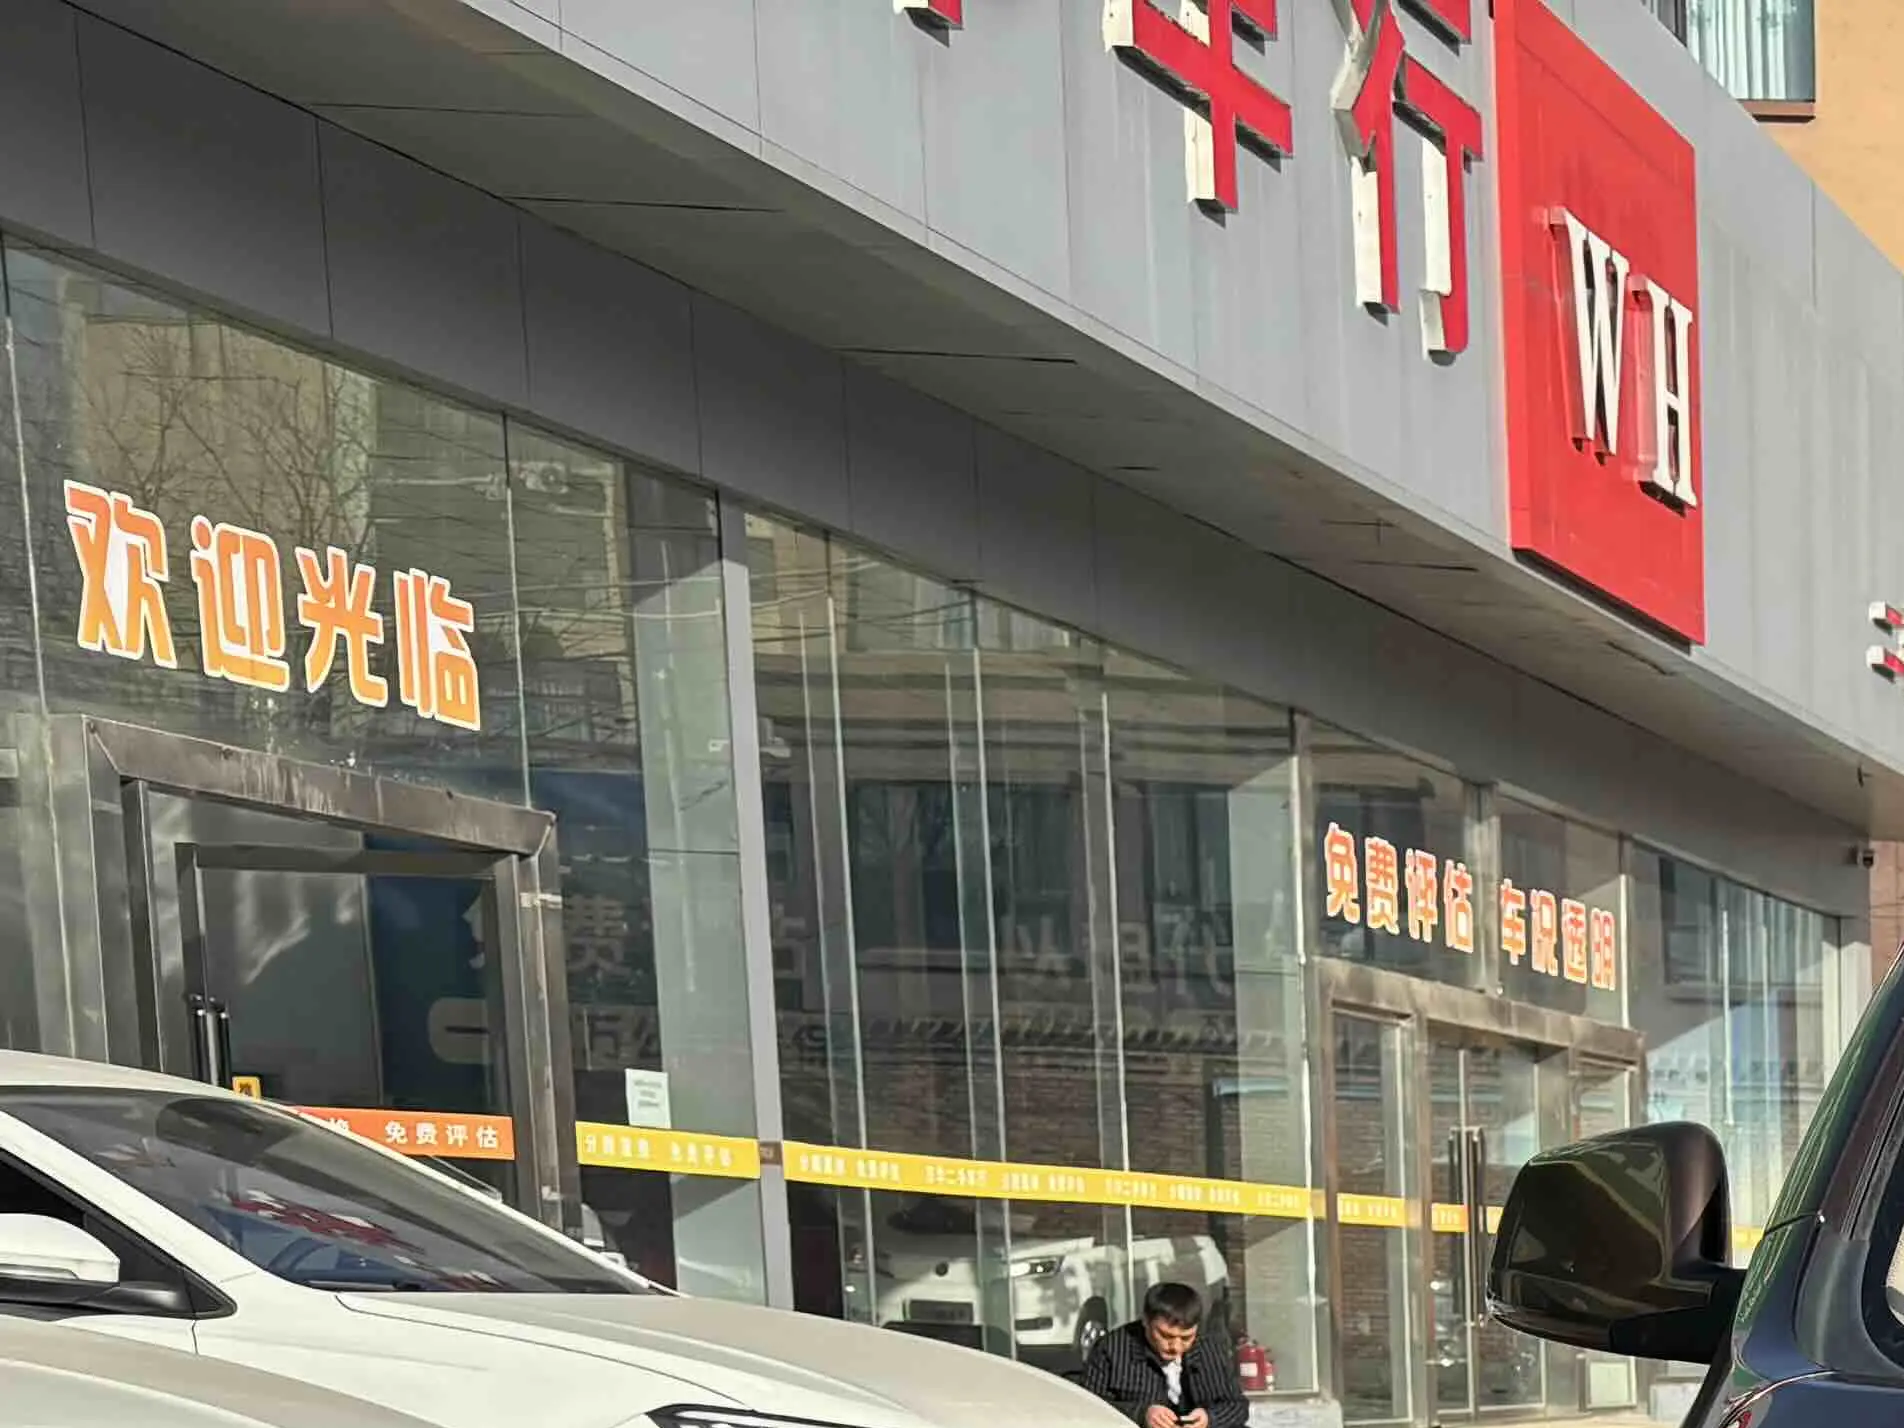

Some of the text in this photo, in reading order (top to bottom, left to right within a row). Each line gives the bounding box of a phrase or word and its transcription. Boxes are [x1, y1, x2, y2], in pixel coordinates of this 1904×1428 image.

[1550, 205, 1697, 508] WH
[63, 479, 481, 731] 欢迎光临
[1324, 822, 1474, 954] 免费评估
[1500, 878, 1616, 991] 车况透明
[384, 1119, 499, 1149] 免费评估
